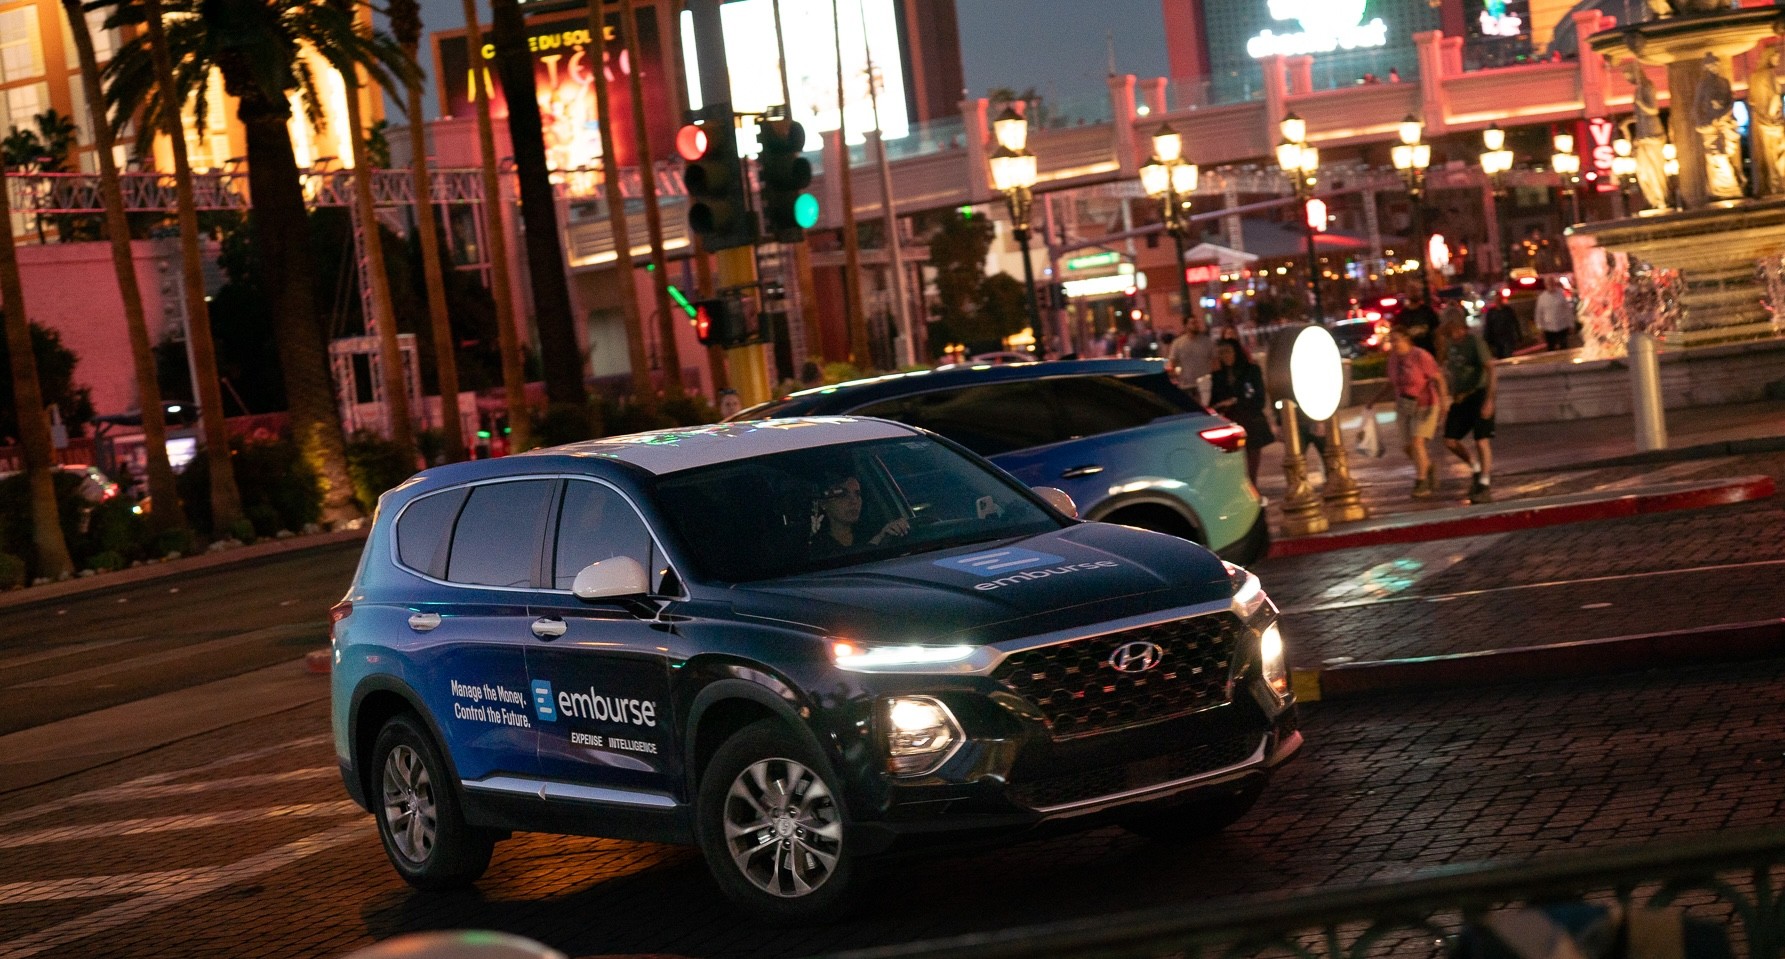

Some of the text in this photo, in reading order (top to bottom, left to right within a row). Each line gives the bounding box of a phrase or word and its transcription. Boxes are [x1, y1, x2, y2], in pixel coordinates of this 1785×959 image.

[538, 33, 562, 50] DU
[974, 560, 1120, 591] emburse
[450, 680, 527, 709] Manage the Money.
[558, 686, 656, 727] emburse
[454, 702, 531, 728] Control the Future.
[571, 732, 658, 755] EXPENSE INTELLIGENCE
